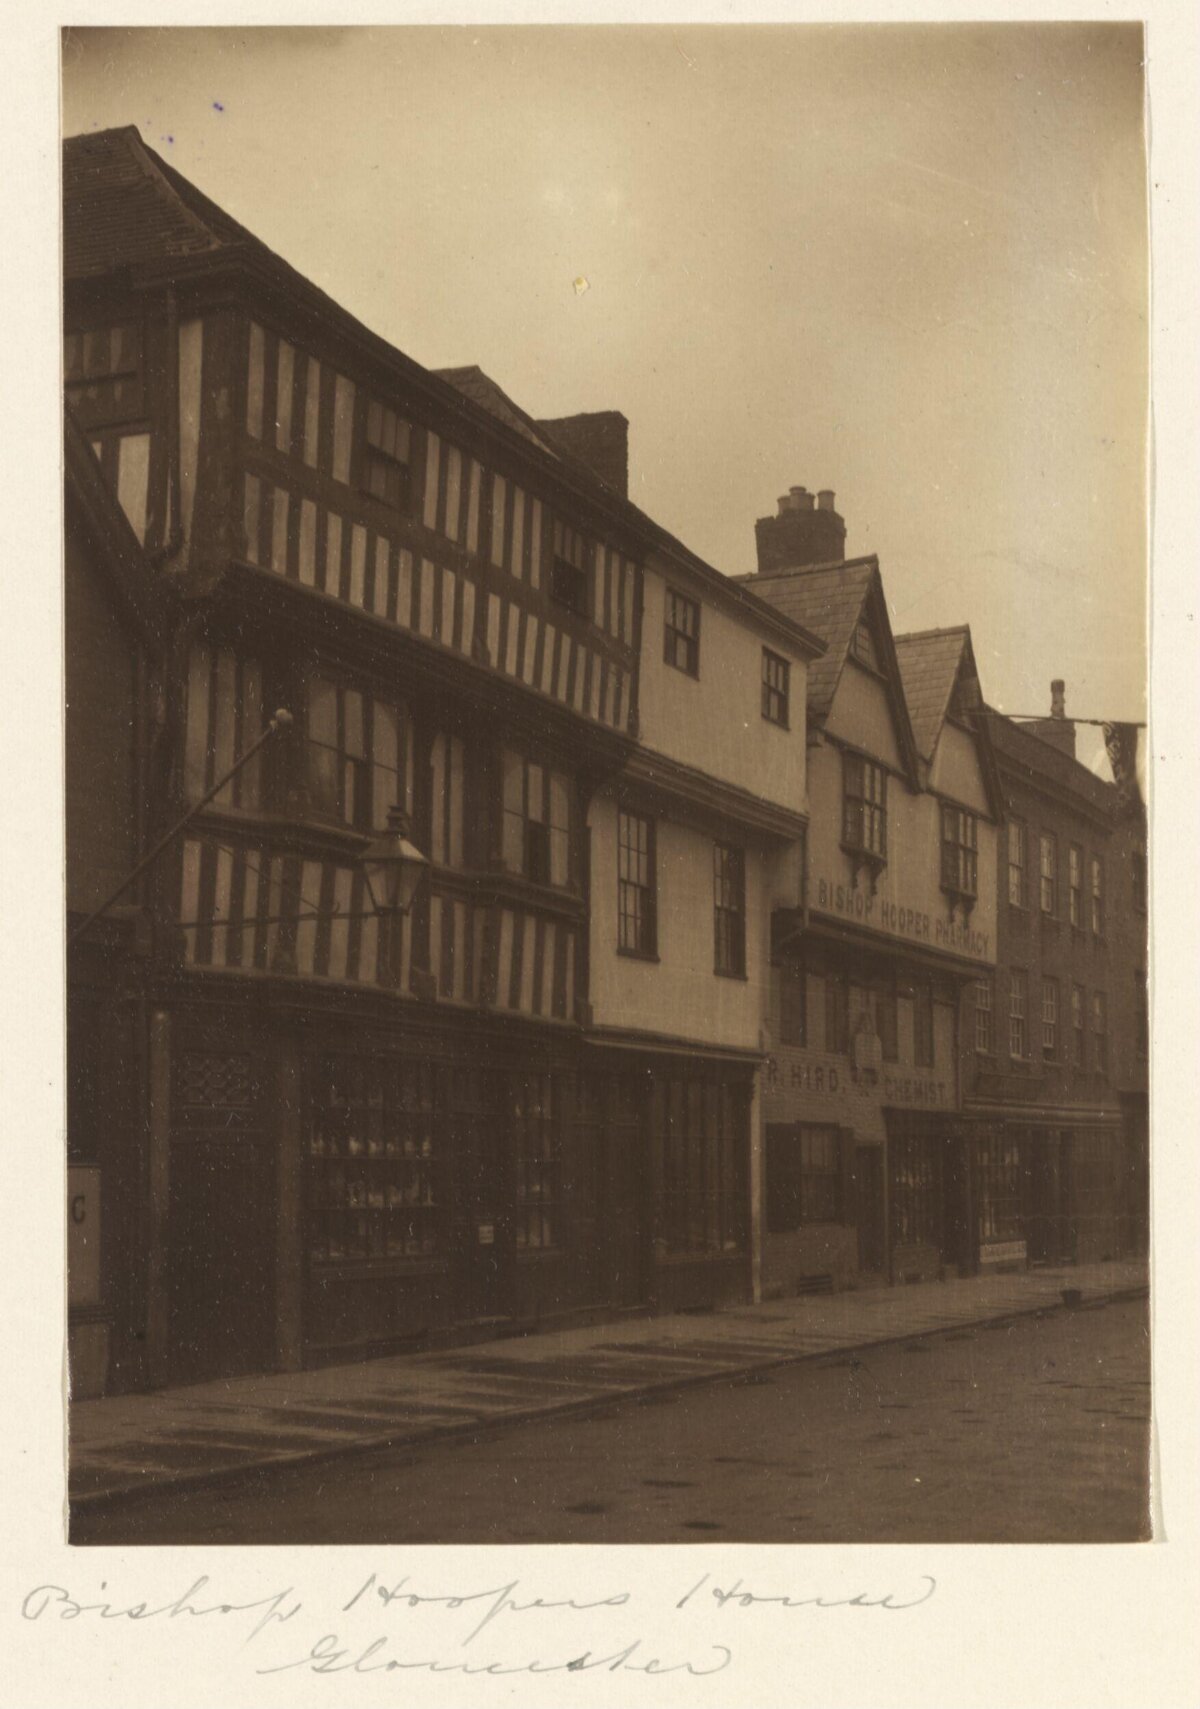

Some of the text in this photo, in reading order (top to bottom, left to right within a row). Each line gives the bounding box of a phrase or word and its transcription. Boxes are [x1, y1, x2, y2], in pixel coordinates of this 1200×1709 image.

[818, 878, 873, 920] BISHOP
[881, 899, 930, 941] HOOPER
[884, 1075, 946, 1105] CHEMIST
[21, 1574, 302, 1643] Bishop
[675, 1574, 937, 1610] House
[255, 1634, 732, 1677] Gloucester
